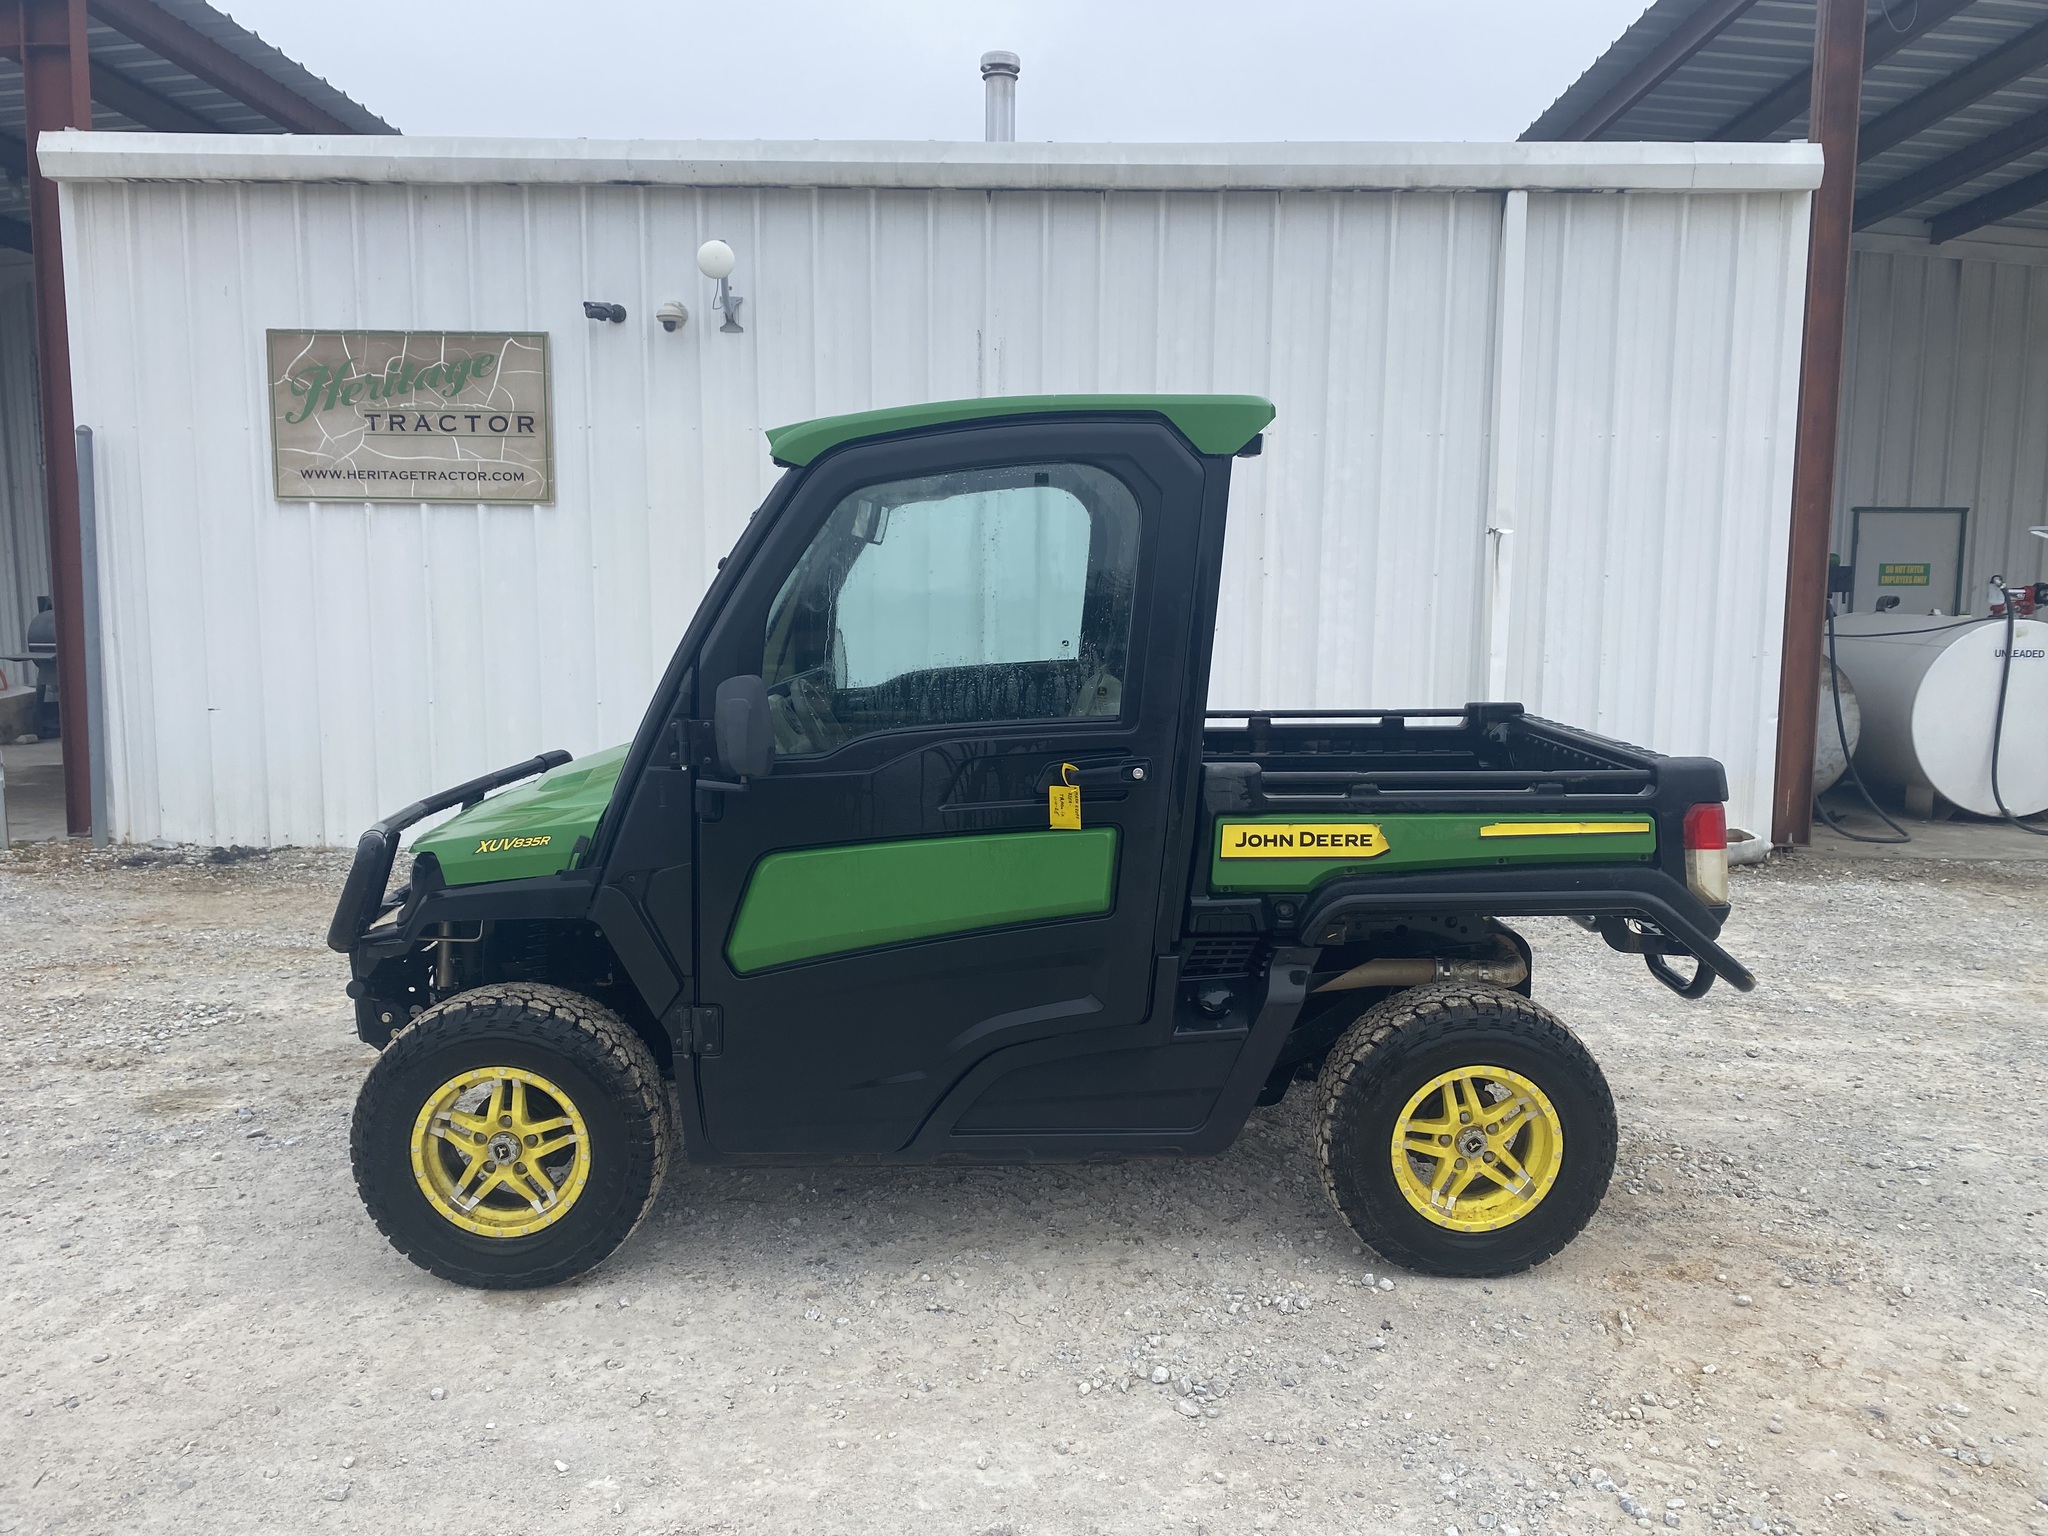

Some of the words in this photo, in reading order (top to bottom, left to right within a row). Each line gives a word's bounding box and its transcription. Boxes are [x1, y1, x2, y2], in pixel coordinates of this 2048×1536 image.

[284, 353, 495, 425] Heritage
[364, 413, 535, 433] TRACTOR
[300, 469, 525, 482] WWW.HERITAGETRACTOR.COM
[473, 835, 552, 855] XUV835R
[1235, 831, 1294, 848] JOHN
[1299, 831, 1372, 848] DEERE
